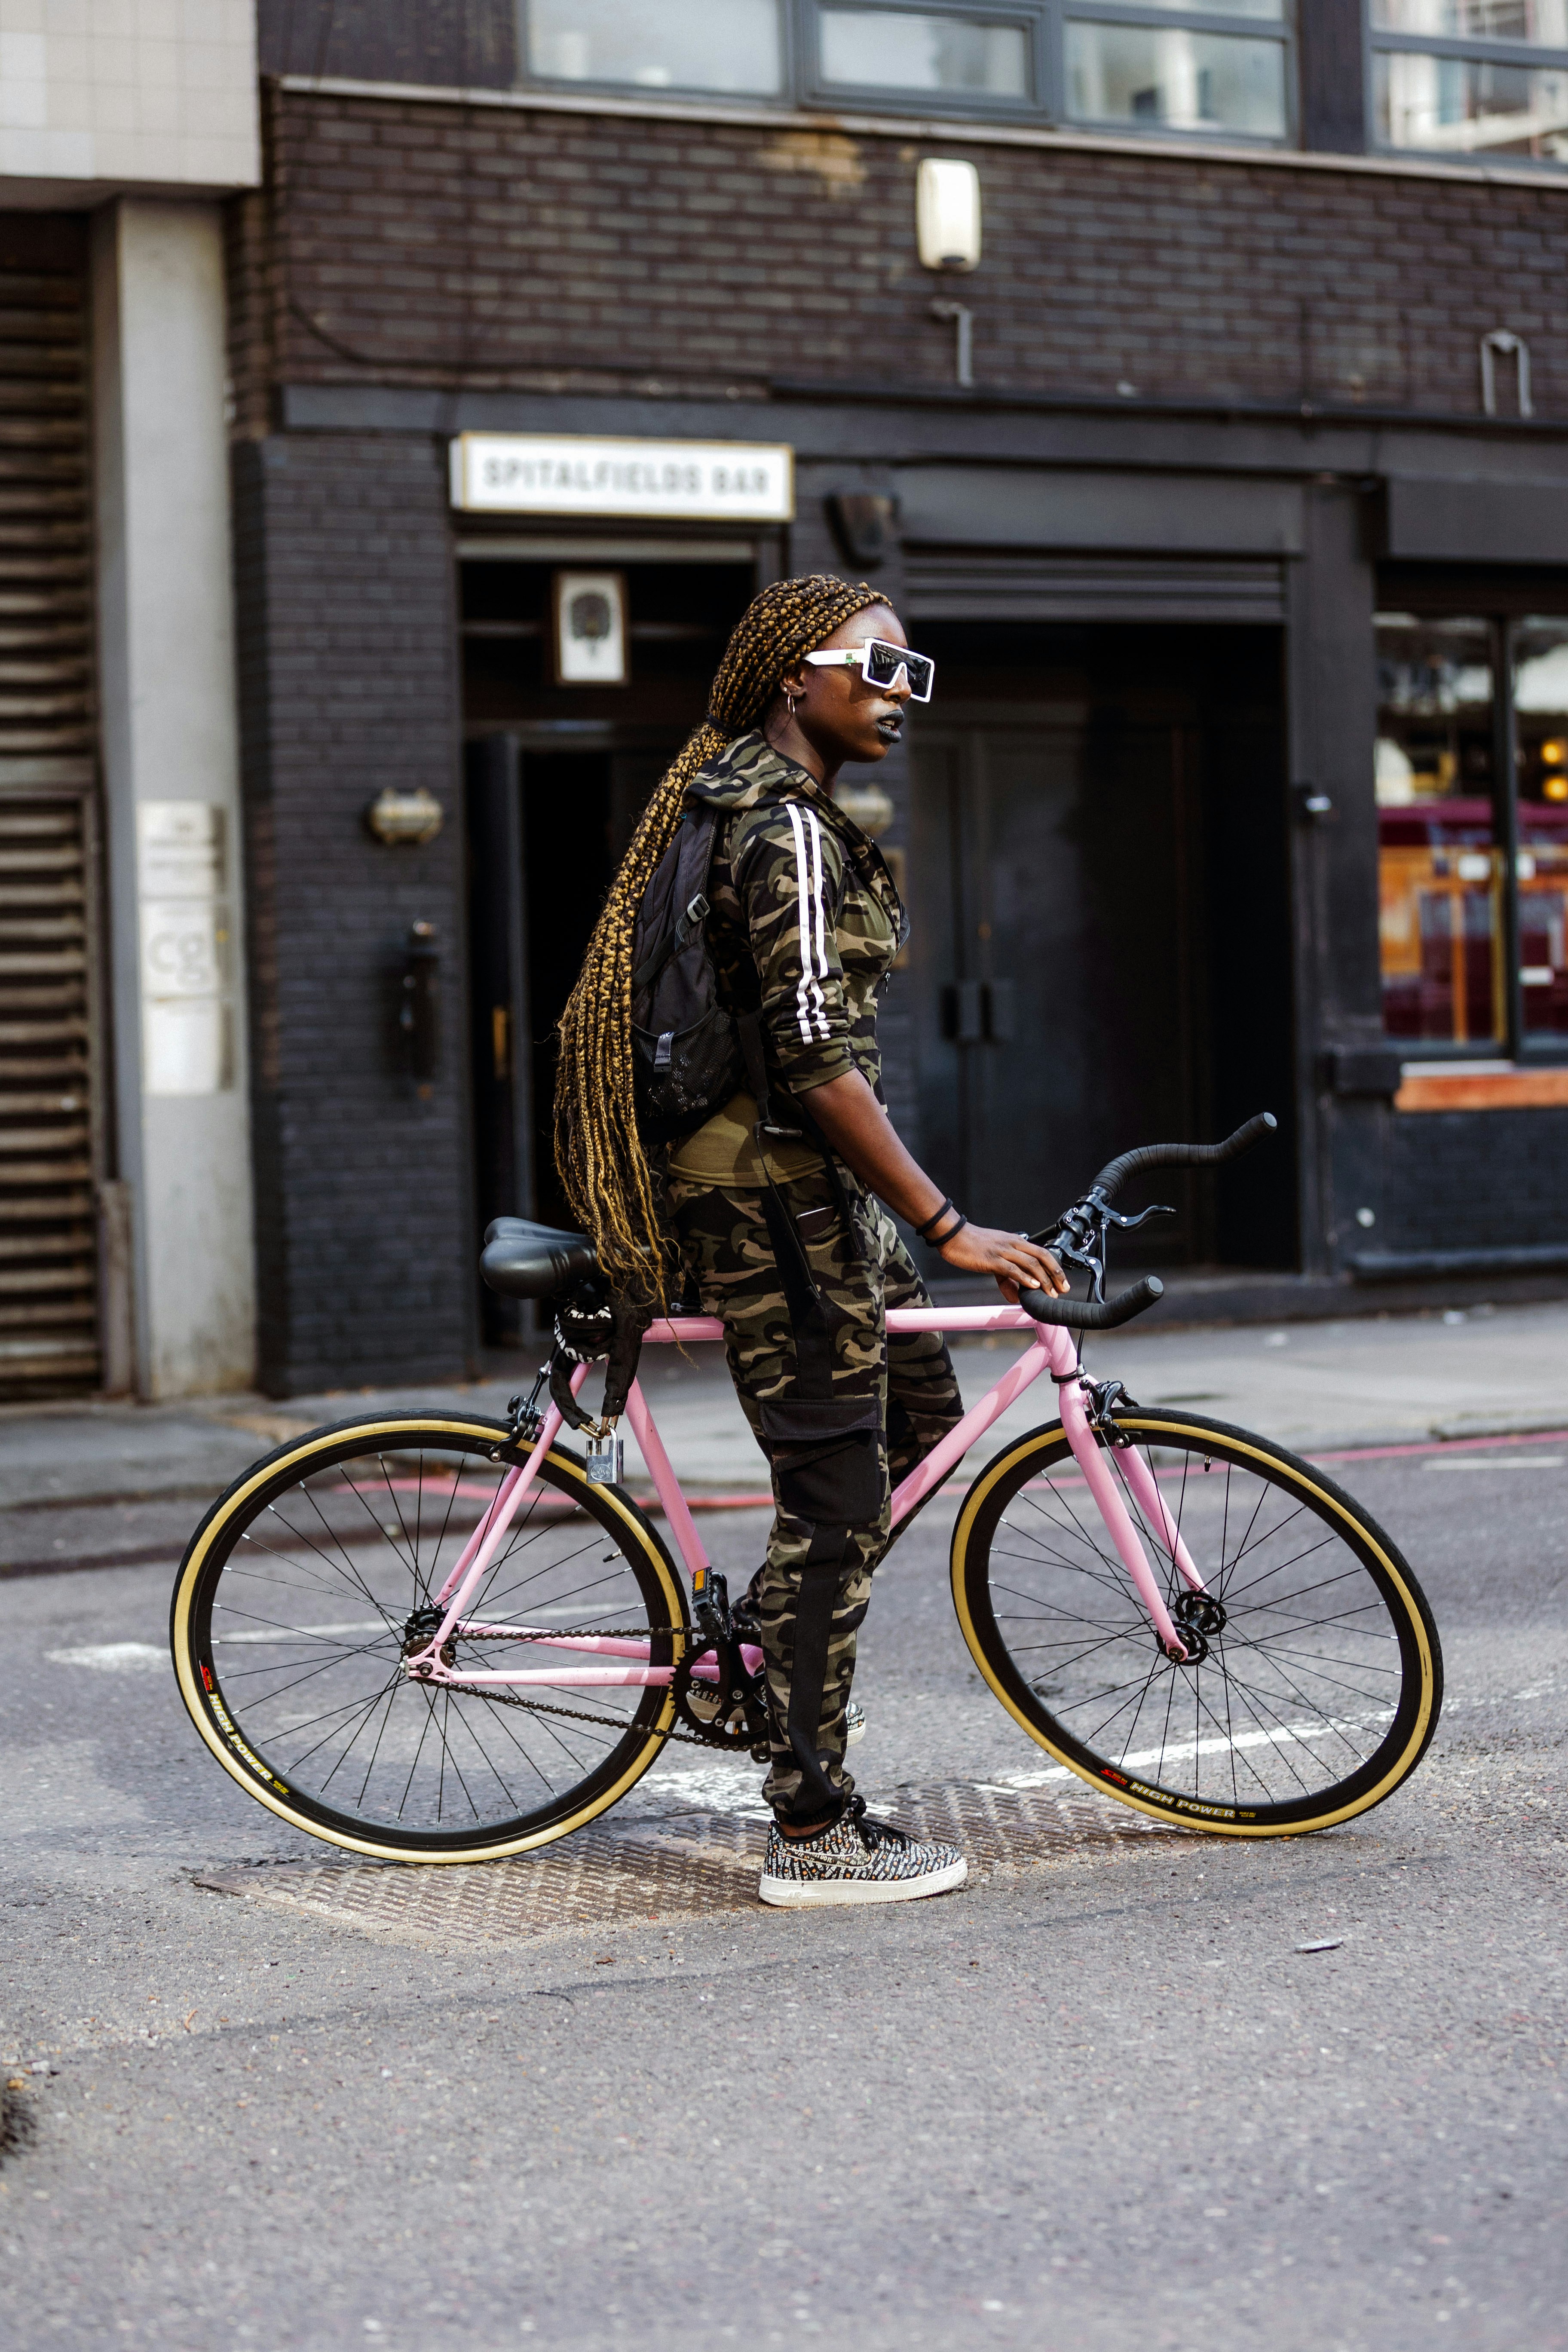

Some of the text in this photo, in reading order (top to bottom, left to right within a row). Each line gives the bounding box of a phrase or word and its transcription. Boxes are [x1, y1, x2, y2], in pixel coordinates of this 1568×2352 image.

[483, 456, 769, 496] SPITALFIELDS BAR
[208, 1694, 273, 1781] HIGH POWER
[1130, 1782, 1235, 1819] HIGH POWER
